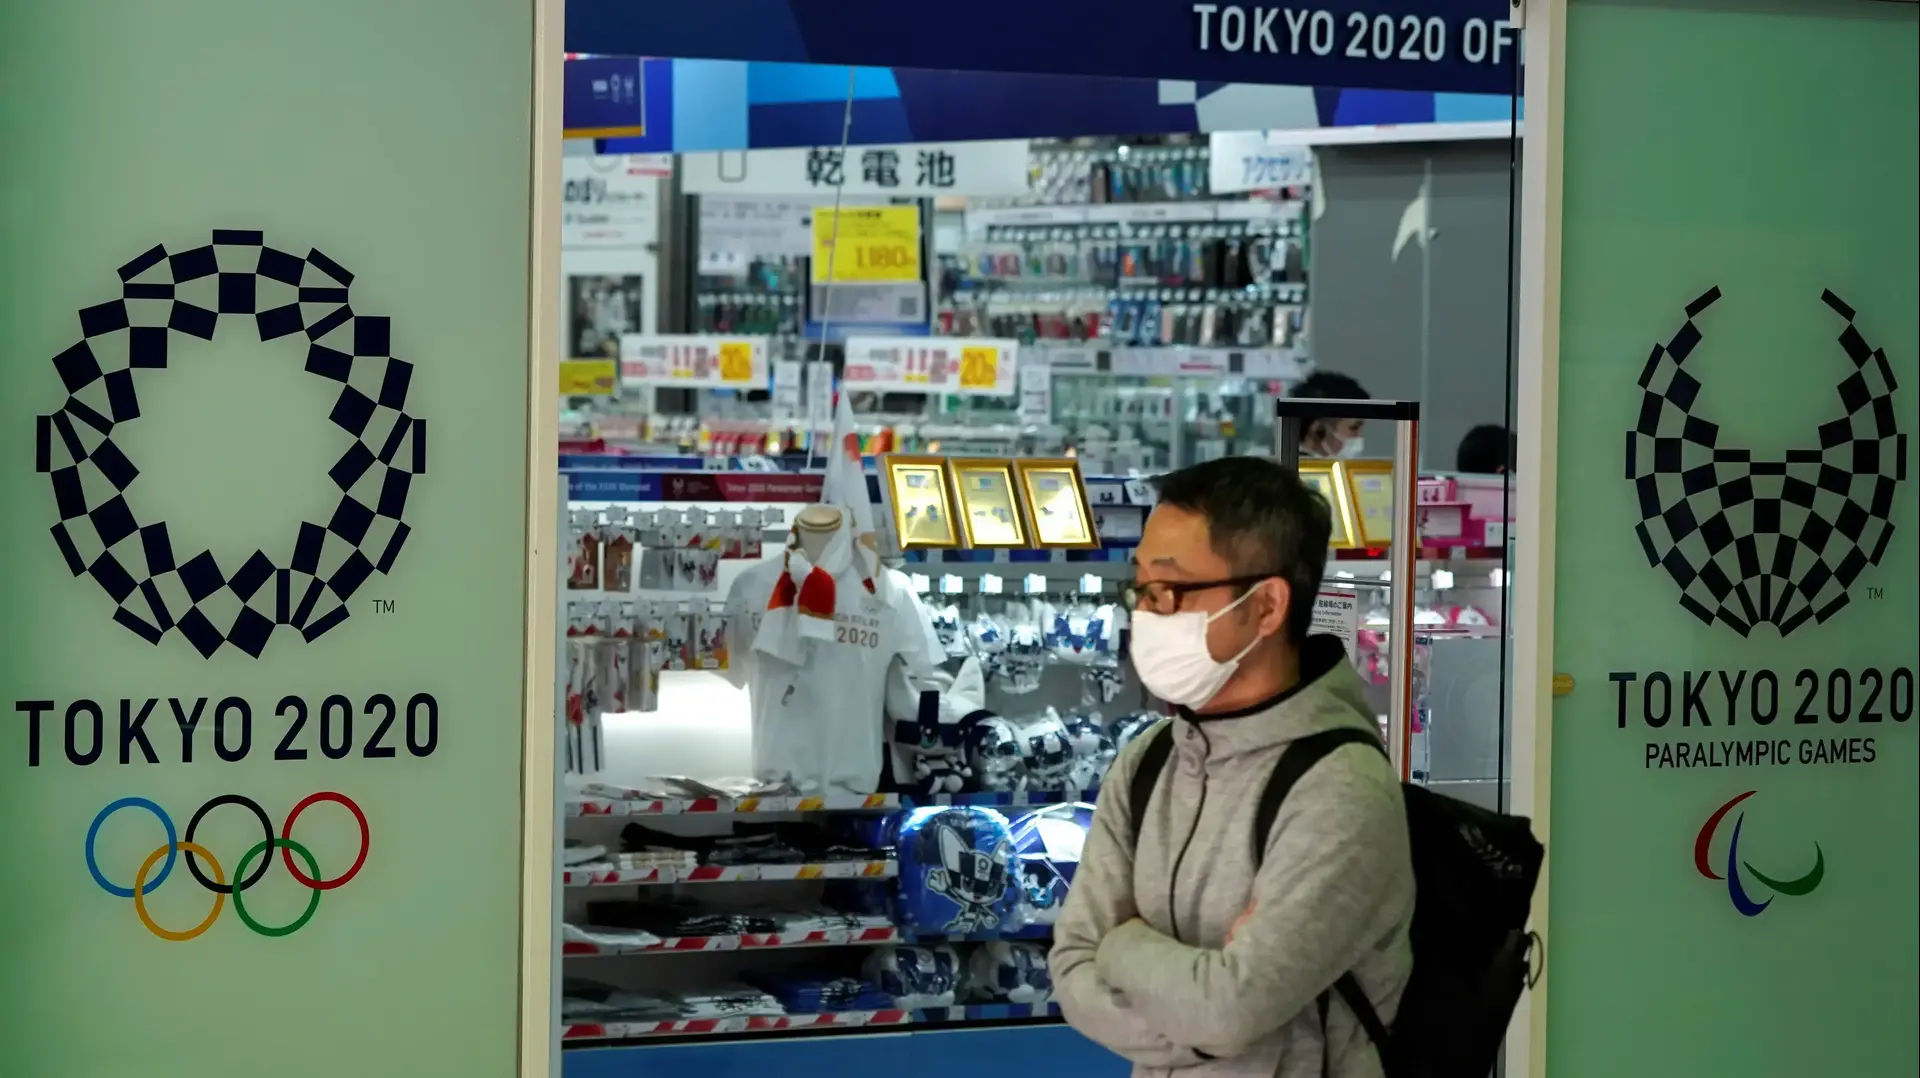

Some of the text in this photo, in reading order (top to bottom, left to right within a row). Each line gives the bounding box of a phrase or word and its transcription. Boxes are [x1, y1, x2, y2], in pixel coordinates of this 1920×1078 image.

[1193, 4, 1334, 55] TOKYO
[1346, 12, 1446, 61] 2020
[806, 147, 956, 187] 乾電池
[372, 599, 395, 614] TM
[1866, 587, 1883, 600] TM
[837, 626, 879, 649] 2020
[1608, 666, 1914, 729] TOKYO 2020
[15, 692, 439, 767] TOKYO 2020
[1645, 737, 1877, 769] PARALYMPIC GAMES
